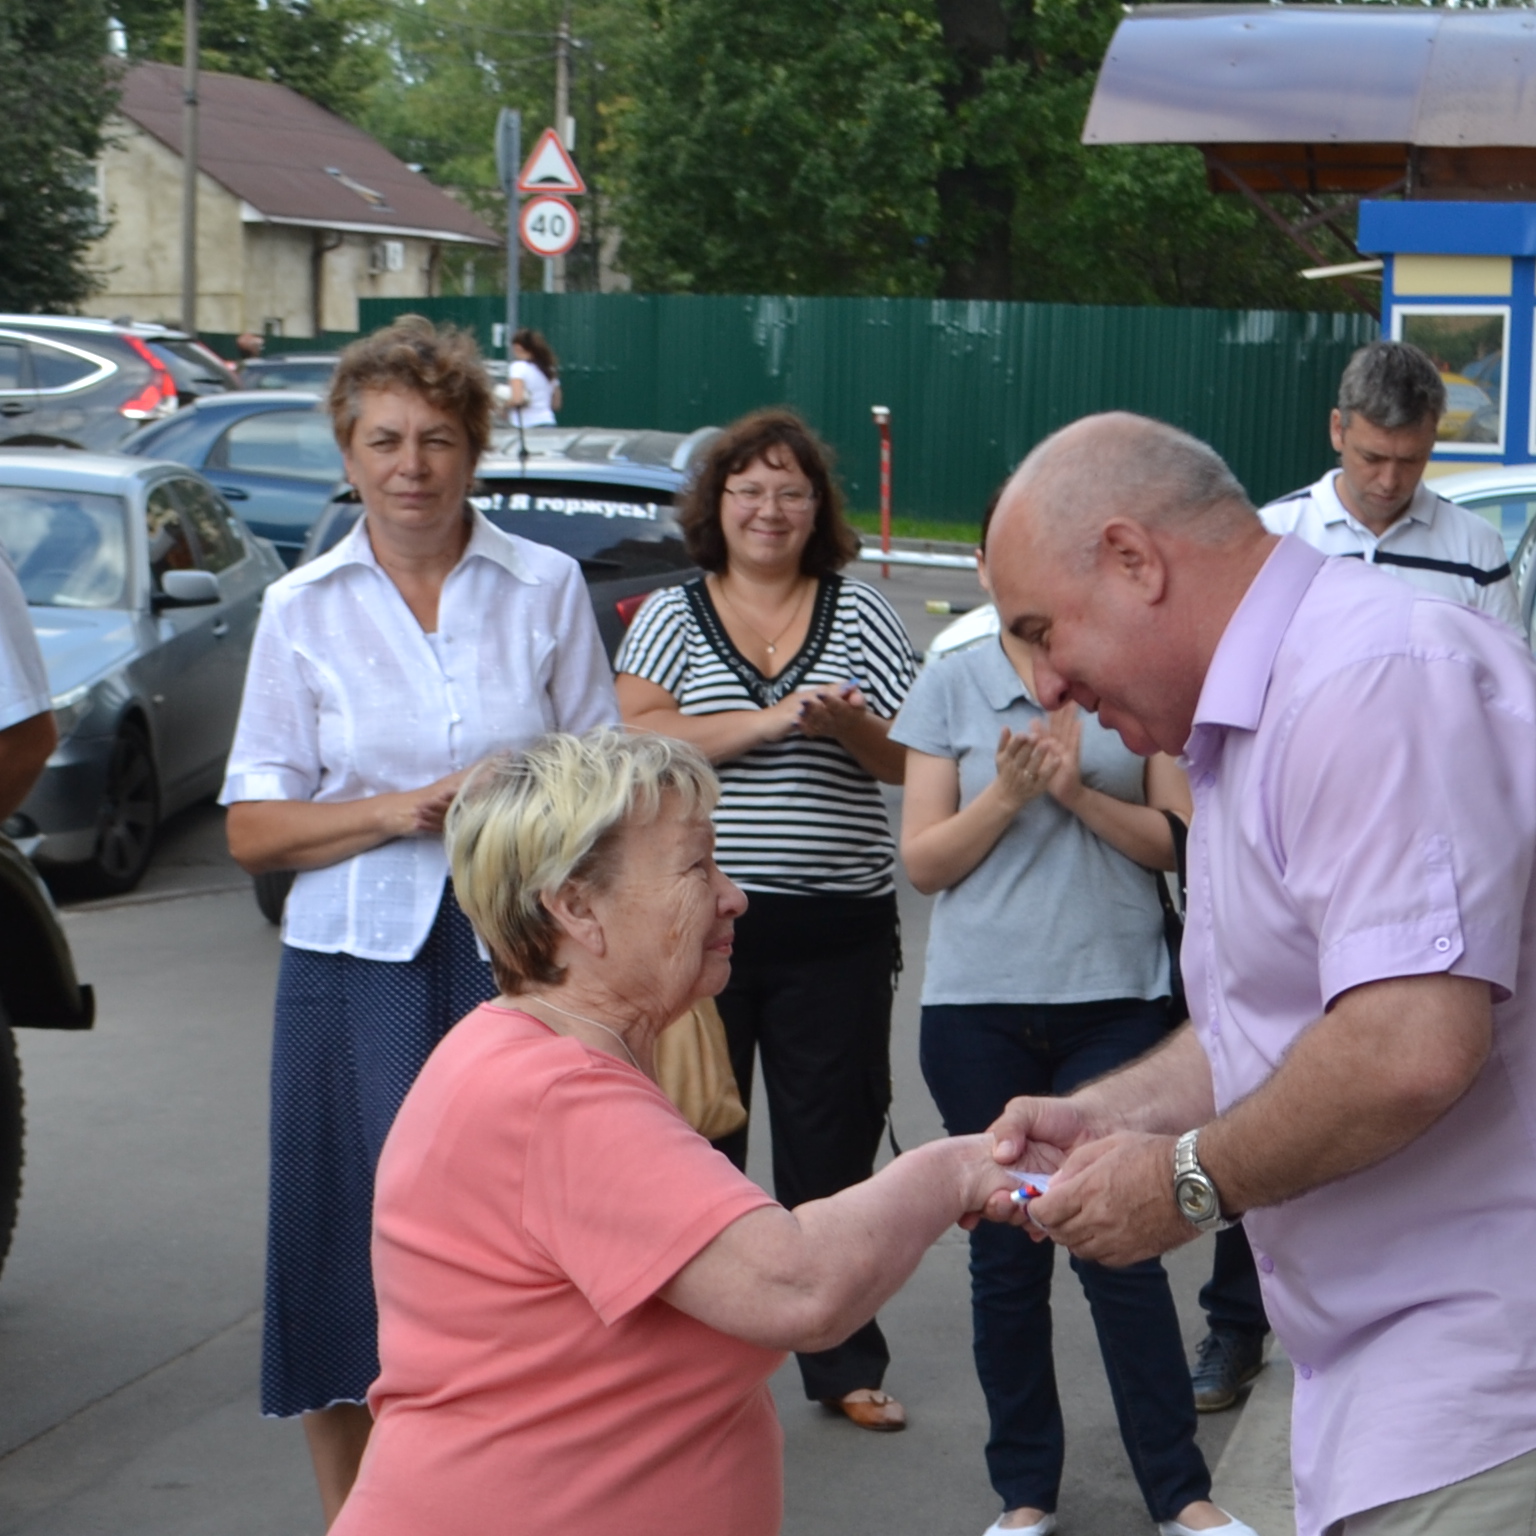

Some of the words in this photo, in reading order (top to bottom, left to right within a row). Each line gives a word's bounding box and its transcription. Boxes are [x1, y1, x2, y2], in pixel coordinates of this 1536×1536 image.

[530, 213, 566, 237] 40
[509, 493, 531, 510] Я
[535, 497, 657, 520] горжусь!
